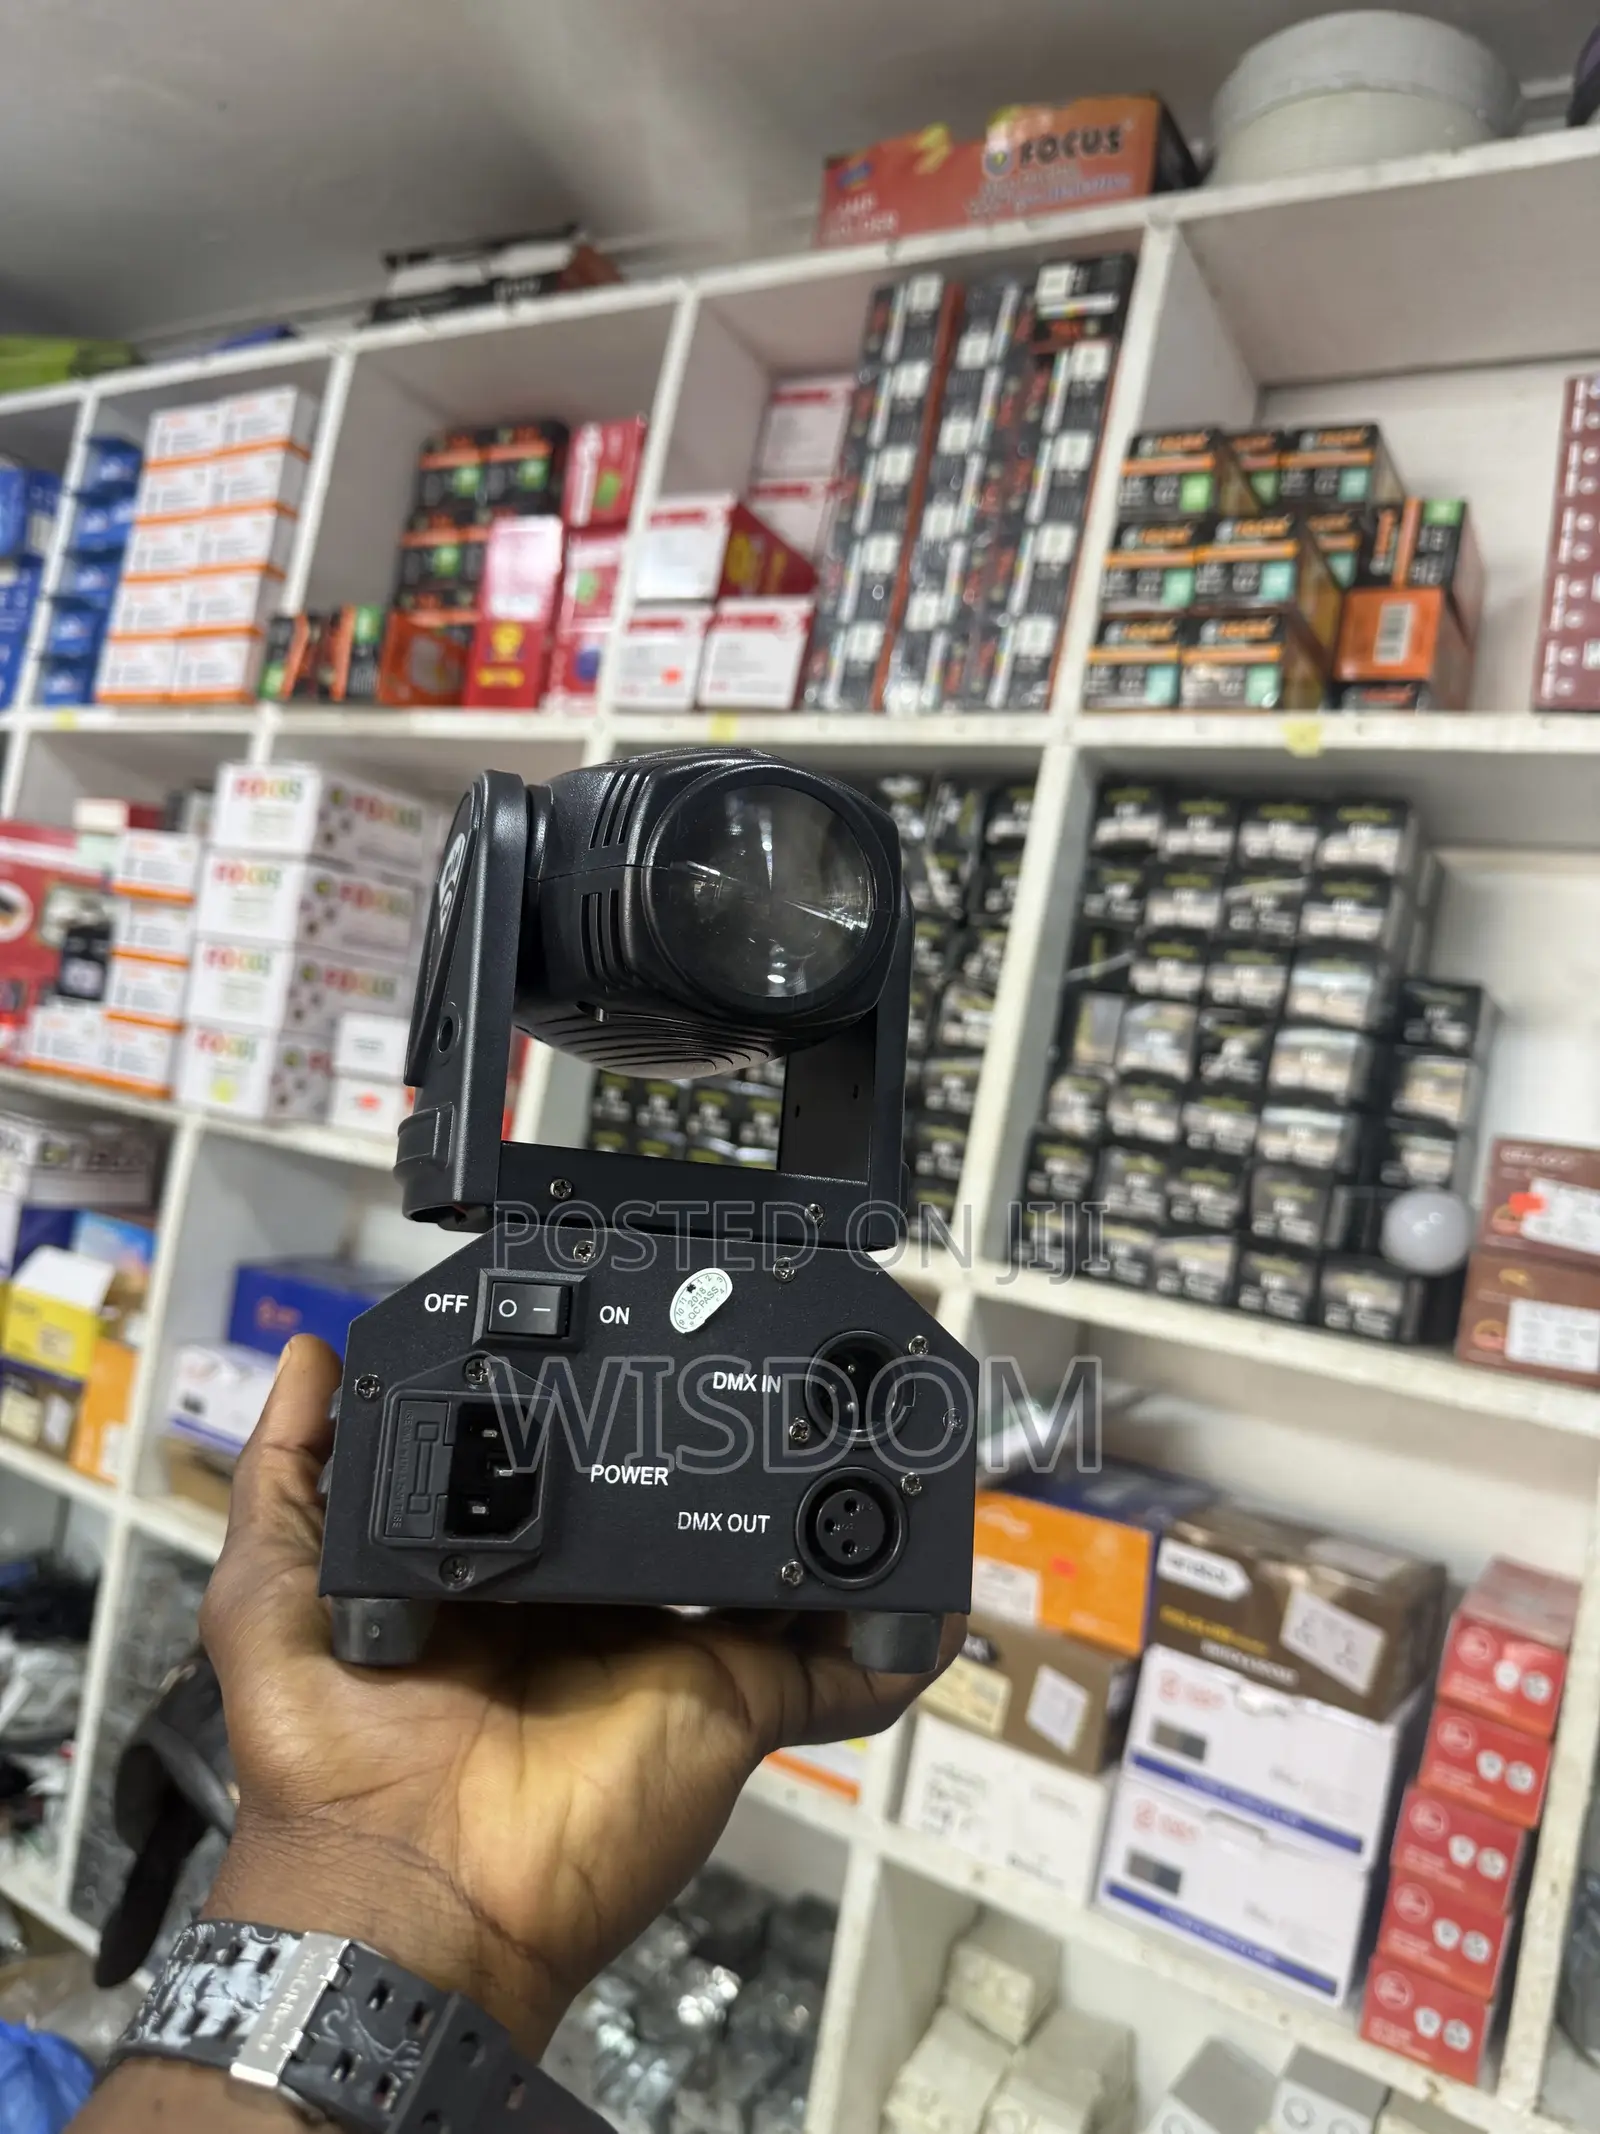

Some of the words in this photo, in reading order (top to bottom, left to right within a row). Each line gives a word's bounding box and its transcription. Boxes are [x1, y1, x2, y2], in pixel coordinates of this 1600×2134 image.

[1019, 123, 1123, 167] FOCUS
[424, 1293, 470, 1313] OFF
[687, 1286, 707, 1308] 2018
[687, 1305, 701, 1320] QC
[698, 1285, 719, 1308] PASS
[599, 1305, 630, 1325] ON
[712, 1371, 757, 1392] DMX
[761, 1374, 782, 1394] IN
[590, 1464, 669, 1486] POWER
[677, 1511, 723, 1532] DMX
[727, 1513, 771, 1534] OUT
